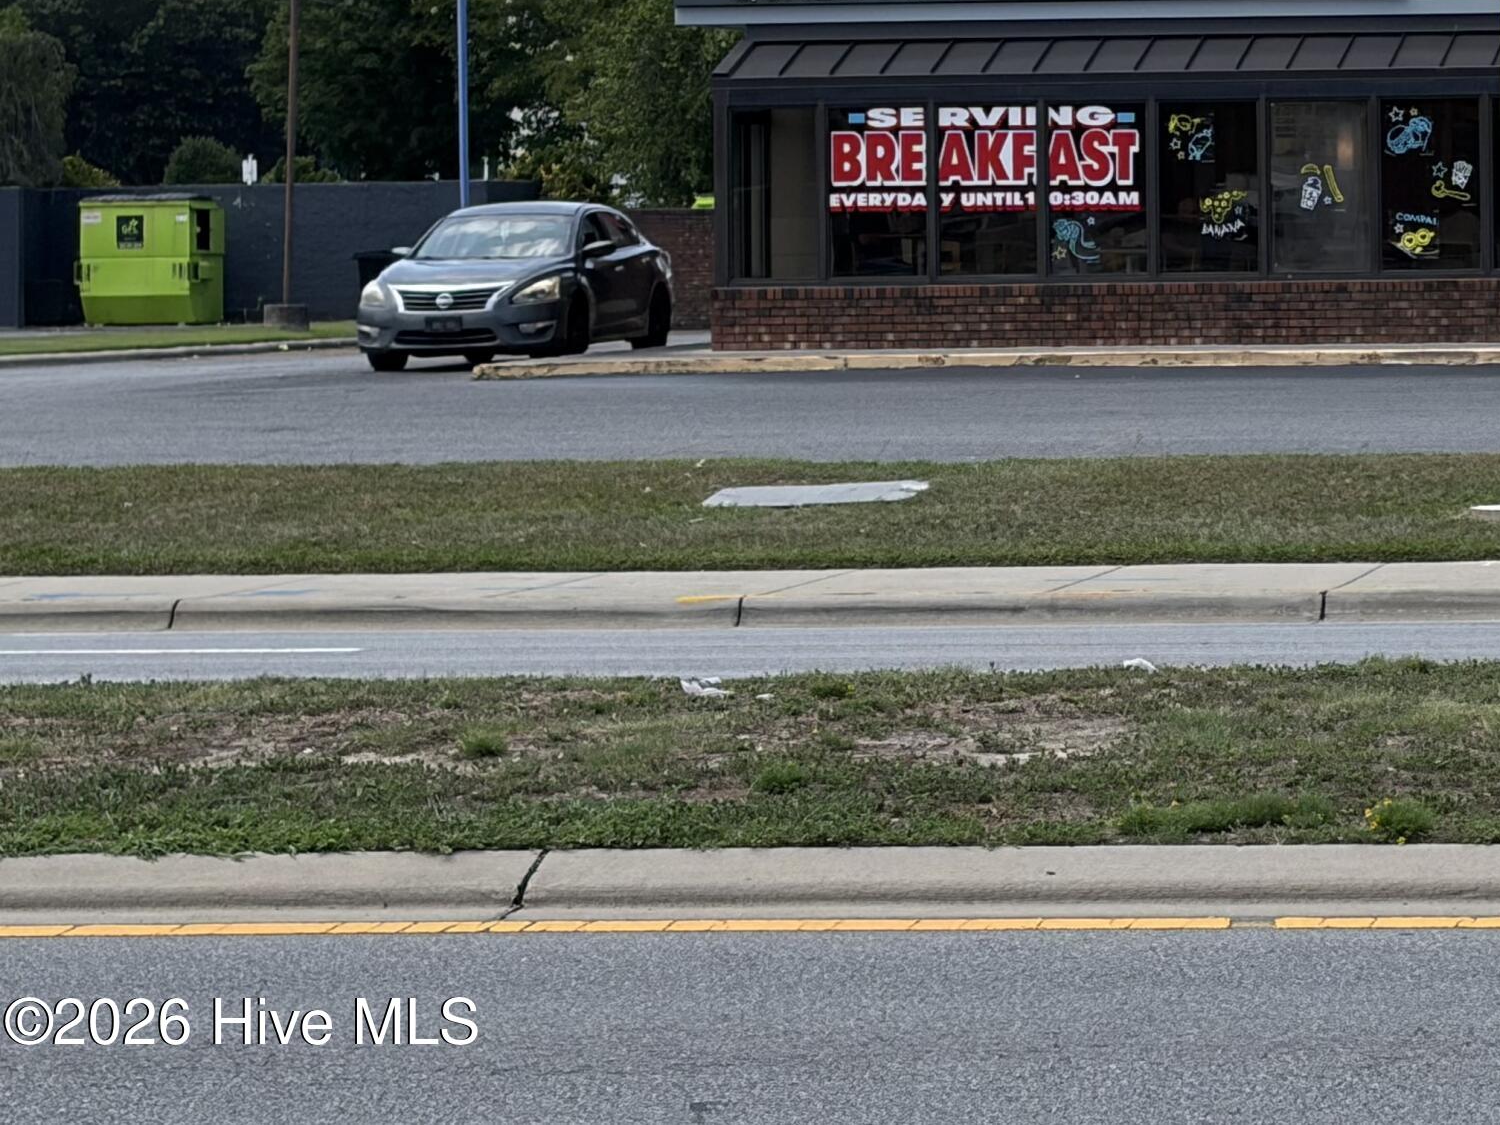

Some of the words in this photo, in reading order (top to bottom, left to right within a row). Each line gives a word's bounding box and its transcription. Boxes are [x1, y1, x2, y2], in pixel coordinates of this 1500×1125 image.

[830, 128, 1140, 187] BREAKFAST
[829, 192, 956, 210] EVERYDAY
[961, 192, 1024, 210] UNTIL
